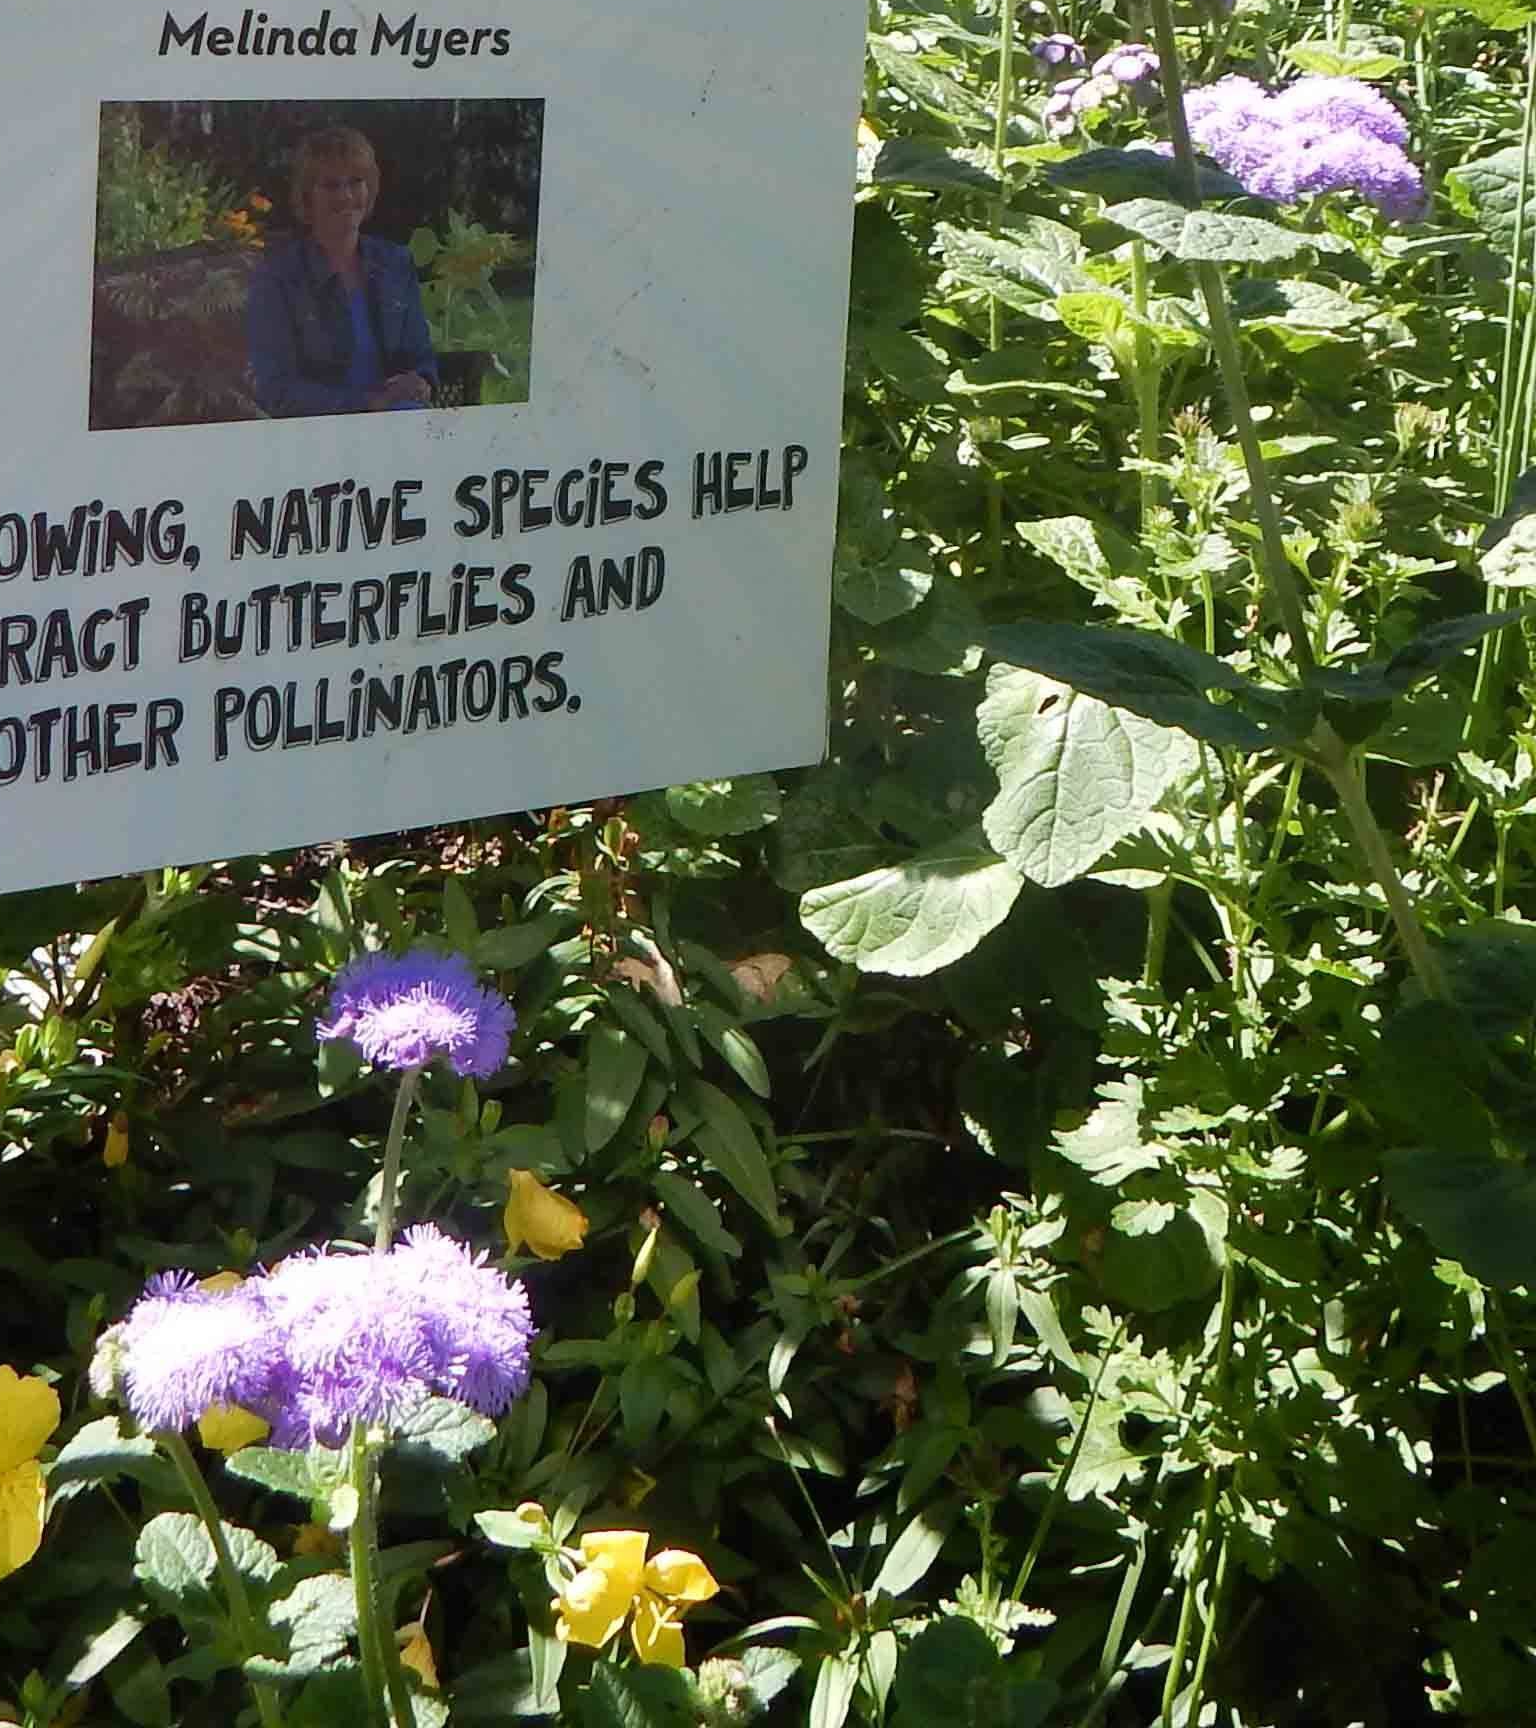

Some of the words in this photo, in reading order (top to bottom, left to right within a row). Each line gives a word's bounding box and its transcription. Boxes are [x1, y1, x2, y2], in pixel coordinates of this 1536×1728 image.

[159, 11, 356, 56] Melinda
[370, 14, 511, 67] Myers
[691, 444, 809, 520] HELP
[561, 545, 665, 622] AND
